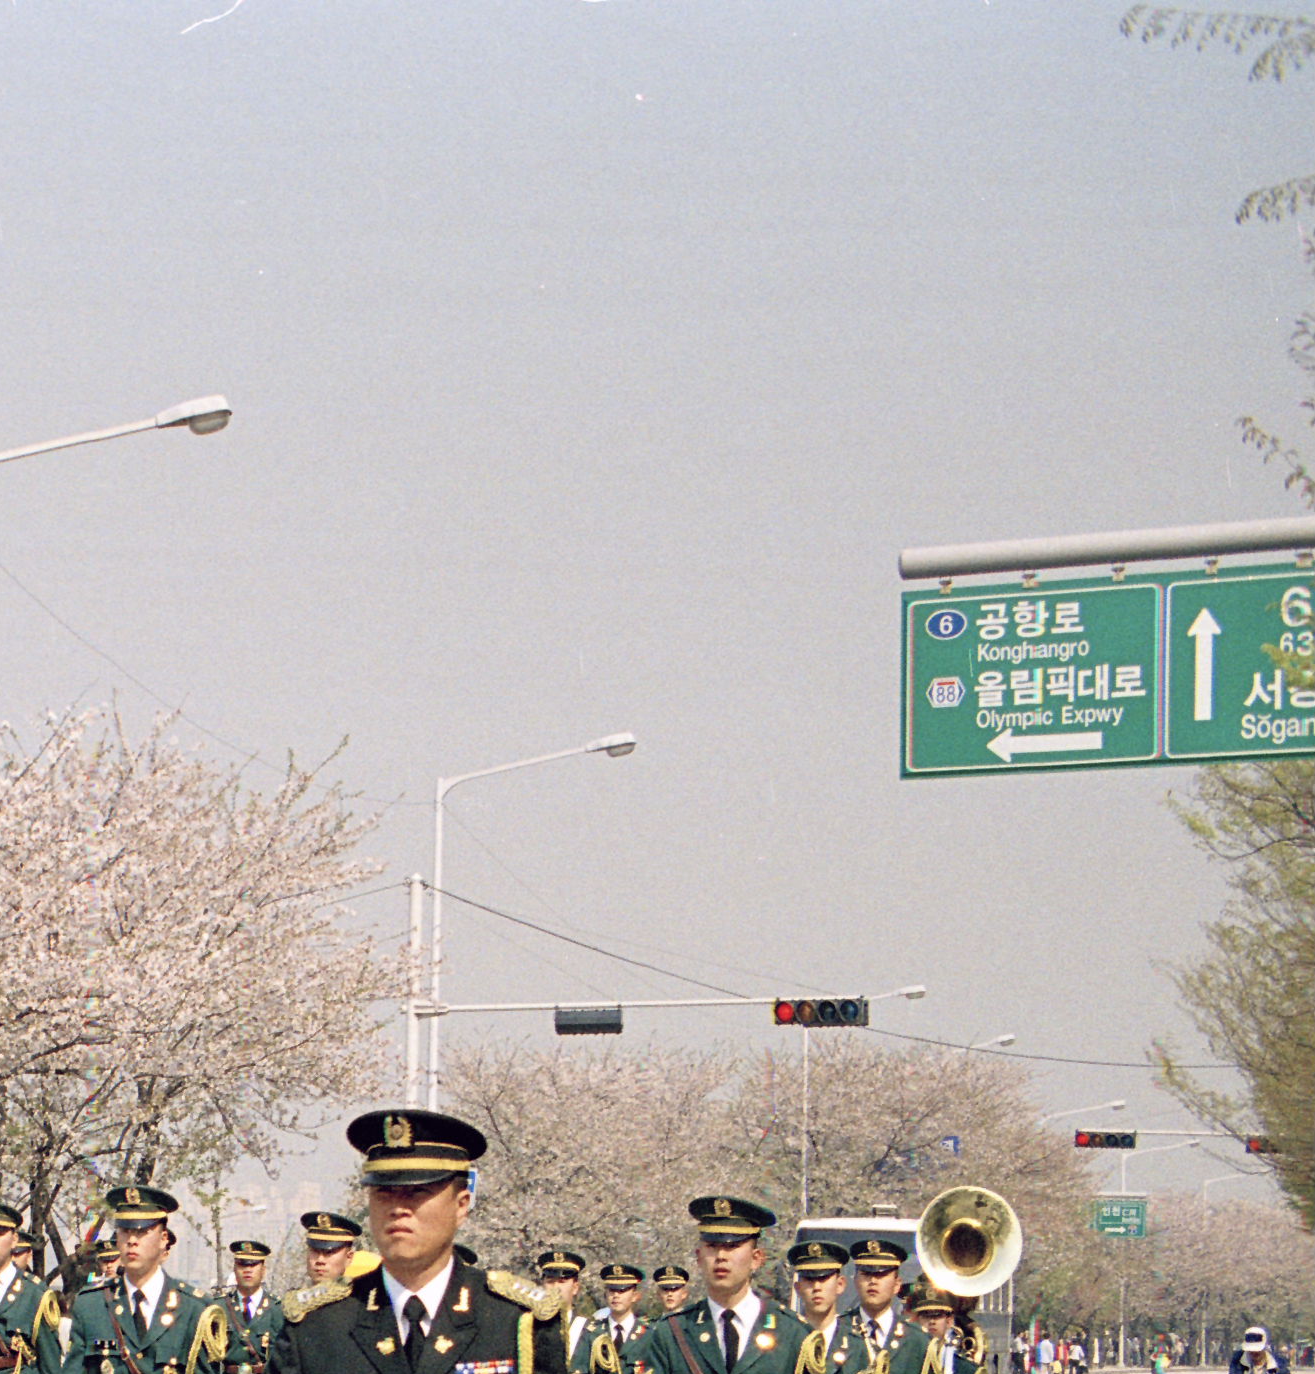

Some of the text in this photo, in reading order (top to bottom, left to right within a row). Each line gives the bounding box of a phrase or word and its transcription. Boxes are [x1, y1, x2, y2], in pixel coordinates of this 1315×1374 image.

[939, 615, 953, 634] 6
[976, 600, 1084, 640] 공항로
[978, 641, 1089, 664] Konghangro
[936, 685, 955, 703] 88
[974, 664, 1146, 707] 올림픽대로
[976, 705, 1123, 732] Olympic Expwy
